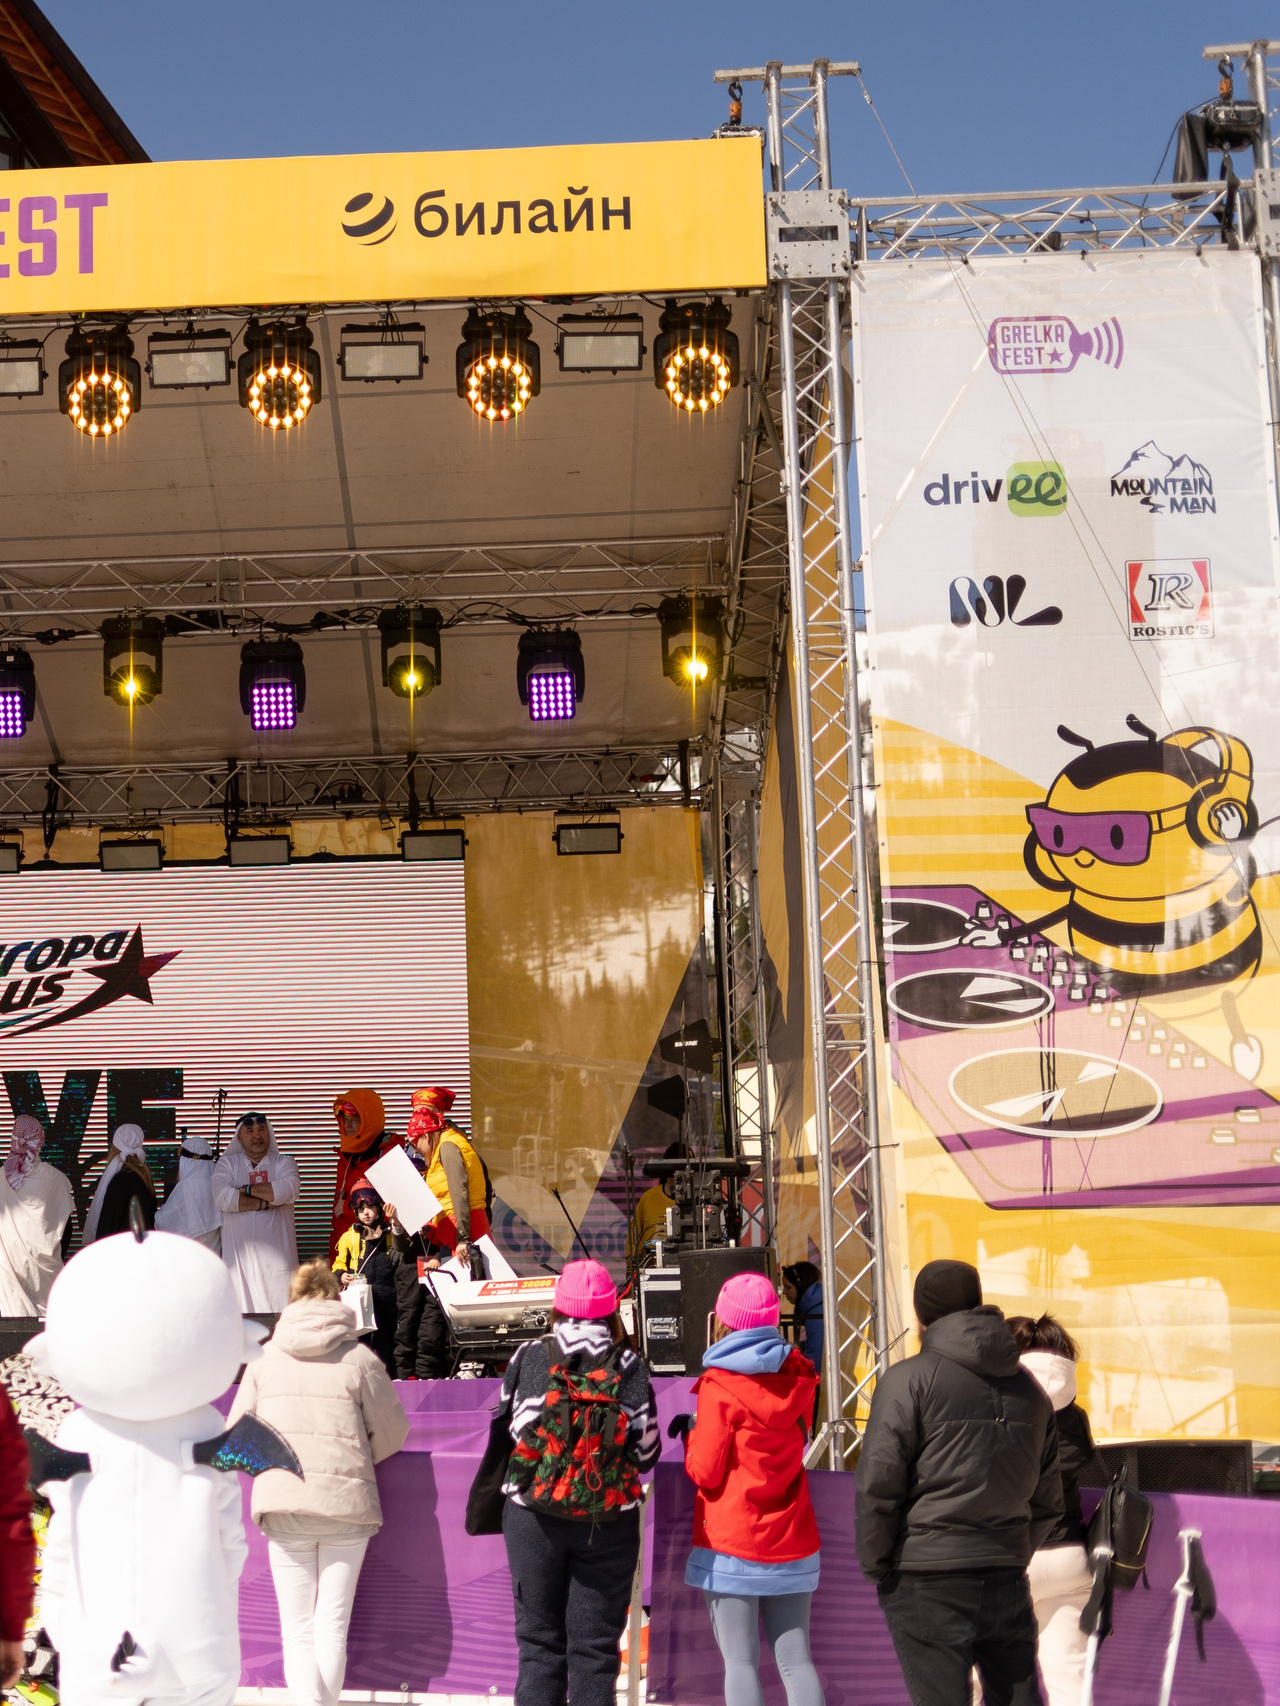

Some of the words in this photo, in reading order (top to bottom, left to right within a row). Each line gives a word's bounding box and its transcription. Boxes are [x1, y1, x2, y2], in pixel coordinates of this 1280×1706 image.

[414, 185, 632, 239] билайн
[1001, 324, 1065, 345] GRELKA
[1001, 347, 1046, 367] FEST
[924, 471, 1067, 507] drivee
[1110, 477, 1214, 497] MOUNTAIN
[1170, 496, 1217, 515] MAN
[1133, 624, 1211, 637] ROSTIC'S
[521, 1279, 552, 1288] 30000
